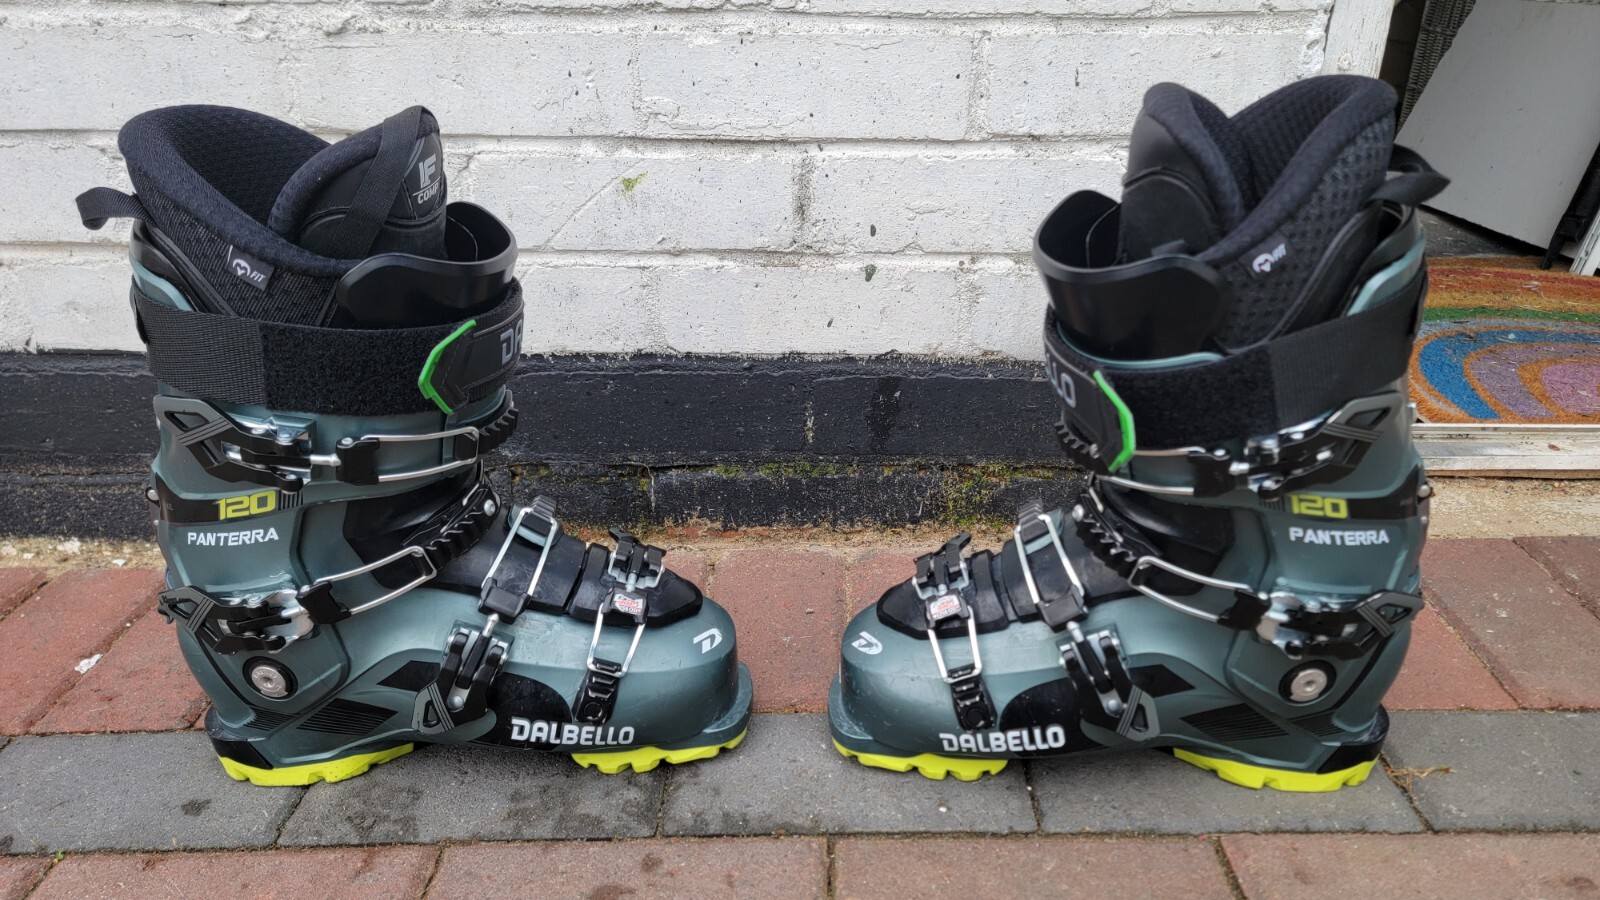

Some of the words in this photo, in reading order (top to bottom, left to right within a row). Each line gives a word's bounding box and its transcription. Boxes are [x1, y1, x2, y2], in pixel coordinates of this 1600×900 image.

[418, 183, 438, 204] COMP
[250, 271, 266, 282] FIT
[217, 490, 276, 520] 120
[1289, 494, 1348, 519] 120
[188, 527, 279, 546] PANTERRA
[1289, 527, 1389, 546] PANTERRA
[511, 716, 635, 745] DALBELLO
[939, 725, 1066, 752] DALBELLO
